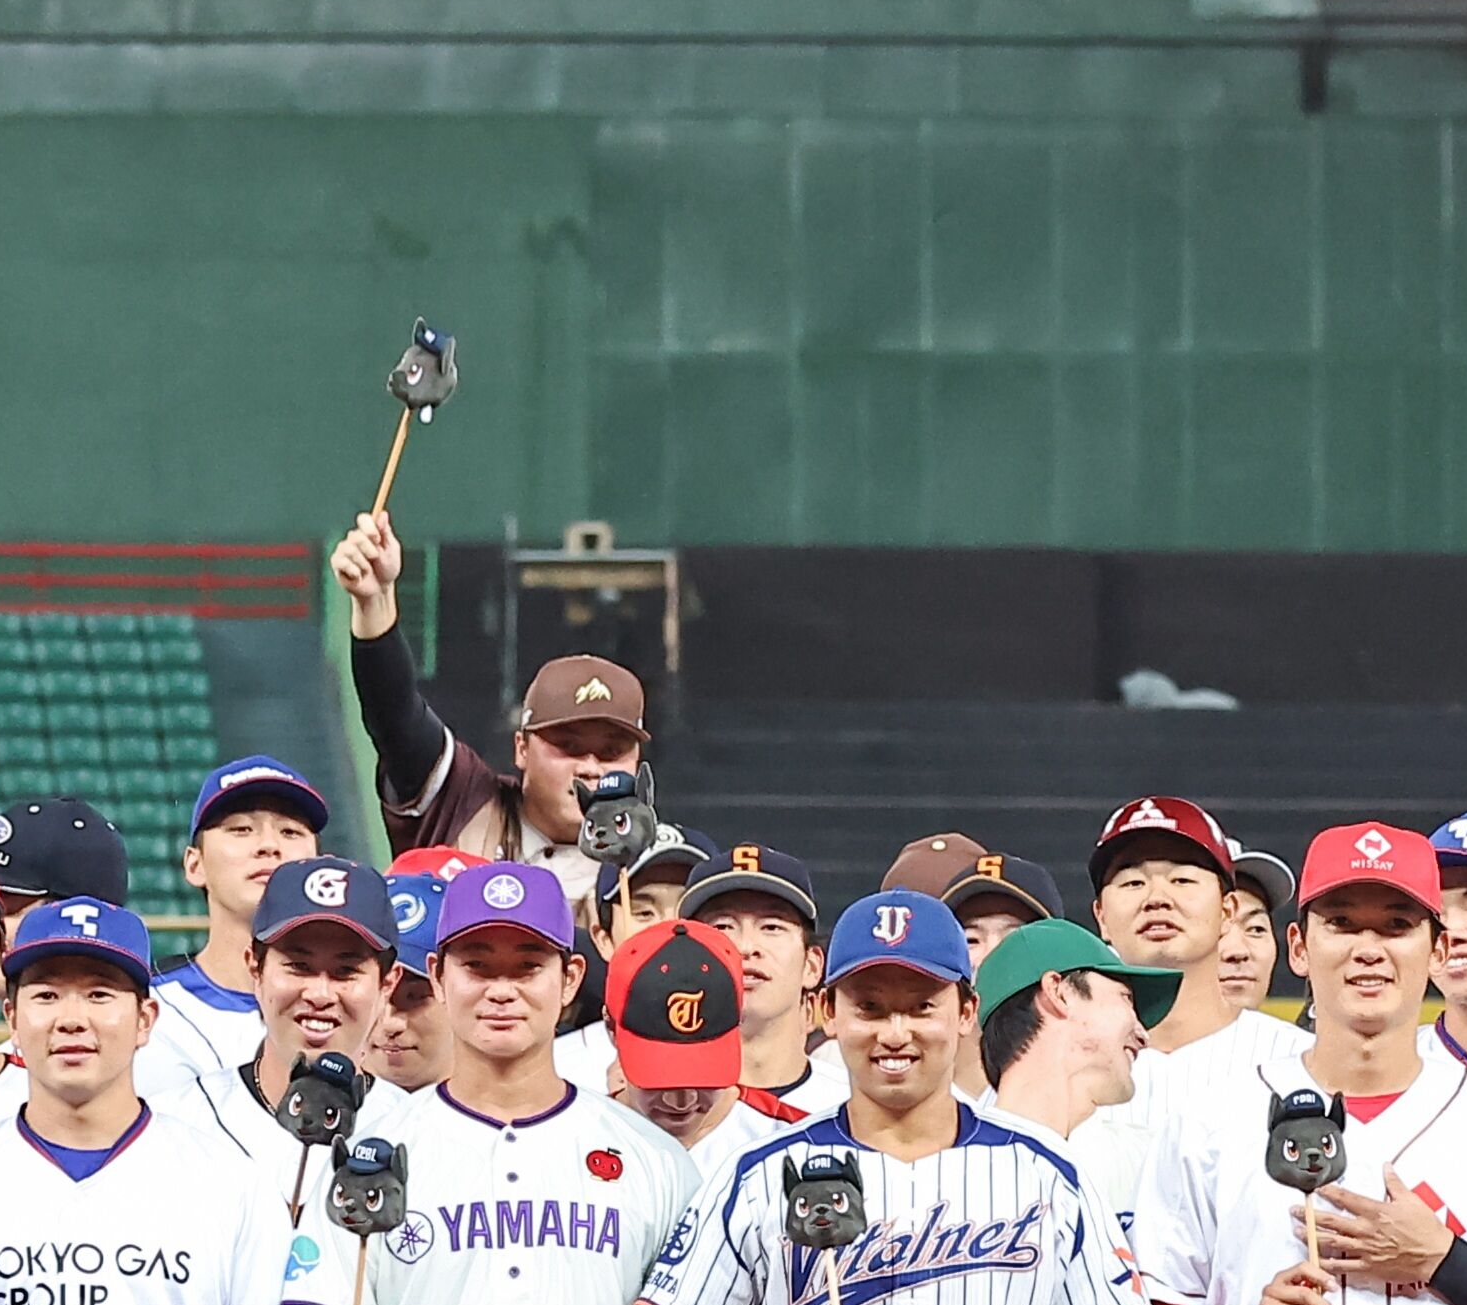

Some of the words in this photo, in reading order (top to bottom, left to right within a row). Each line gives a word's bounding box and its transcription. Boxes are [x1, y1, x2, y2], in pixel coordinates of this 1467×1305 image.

[1350, 859, 1395, 872] NISSAY
[437, 1199, 621, 1259] YAMAHA
[116, 1243, 191, 1284] GAS
